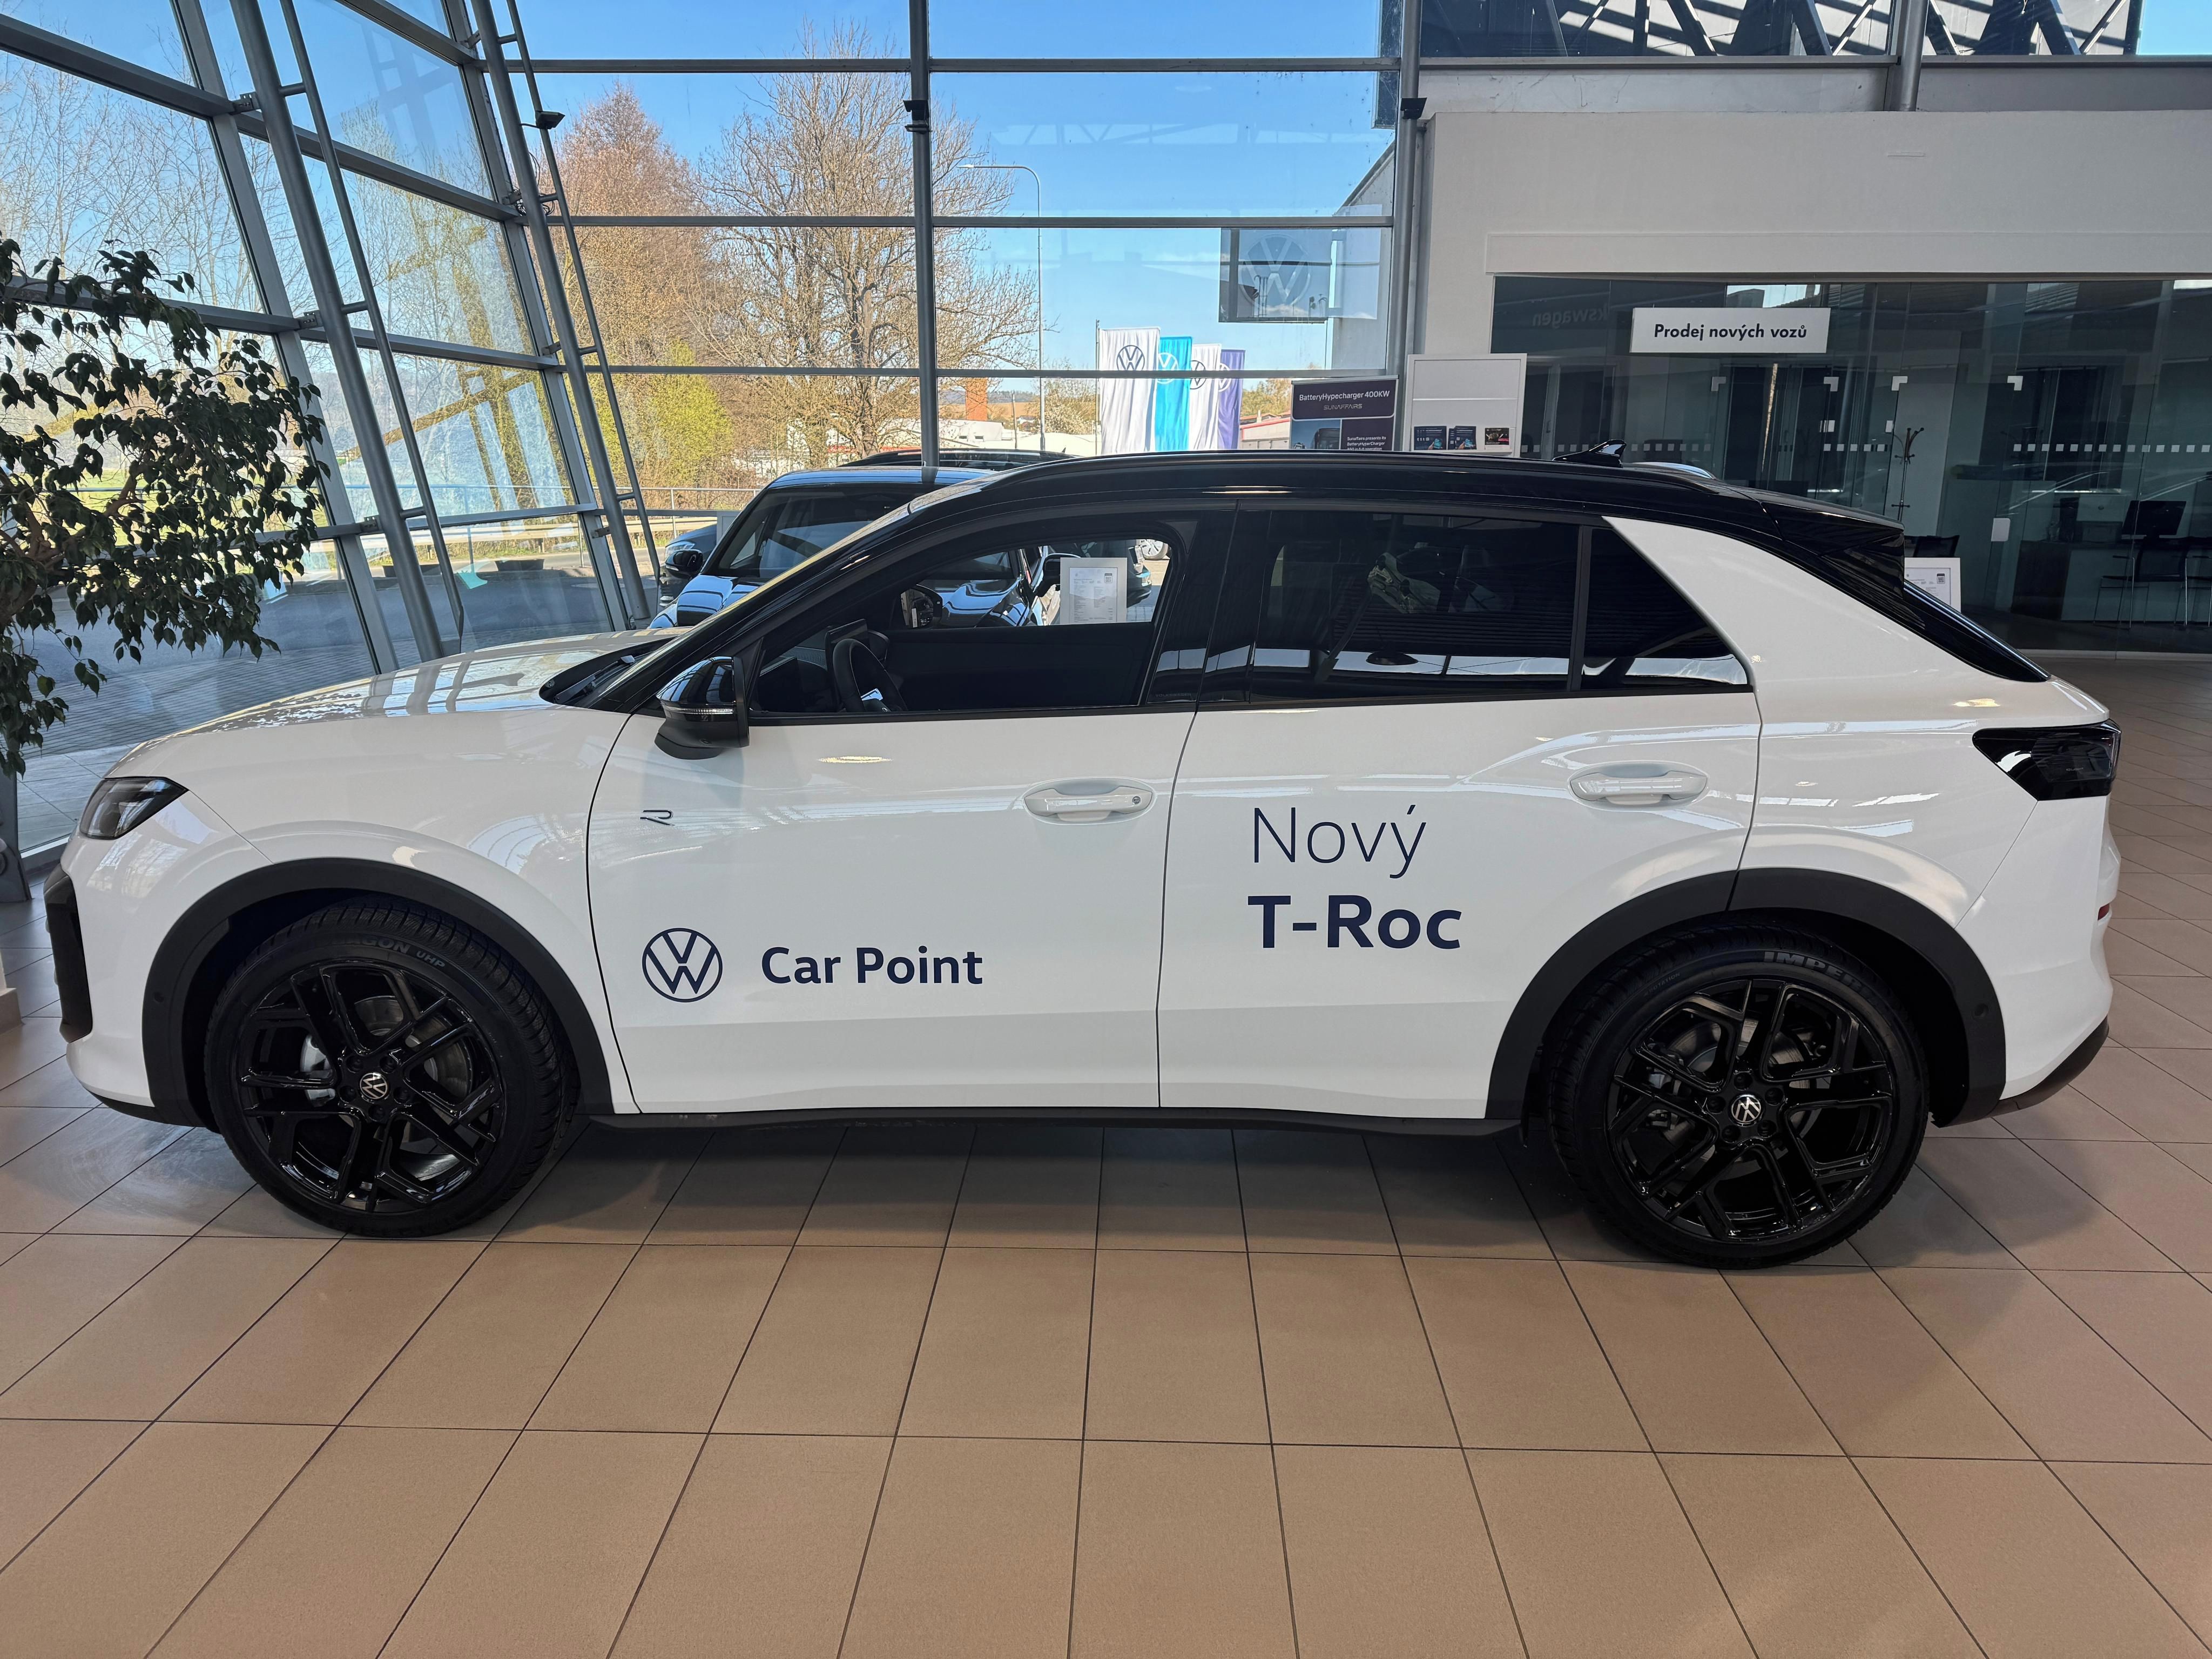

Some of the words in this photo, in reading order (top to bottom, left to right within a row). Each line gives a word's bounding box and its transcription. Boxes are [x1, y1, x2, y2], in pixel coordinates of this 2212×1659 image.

[1654, 323, 1704, 341] Prodej
[1709, 323, 1764, 341] nových
[1770, 325, 1807, 338] vozů
[639, 809, 675, 826] R
[1253, 804, 1427, 879] Nový
[1247, 894, 1462, 950] T-Roc
[416, 950, 446, 968] UHP
[761, 946, 841, 984] Car
[856, 945, 983, 985] Point
